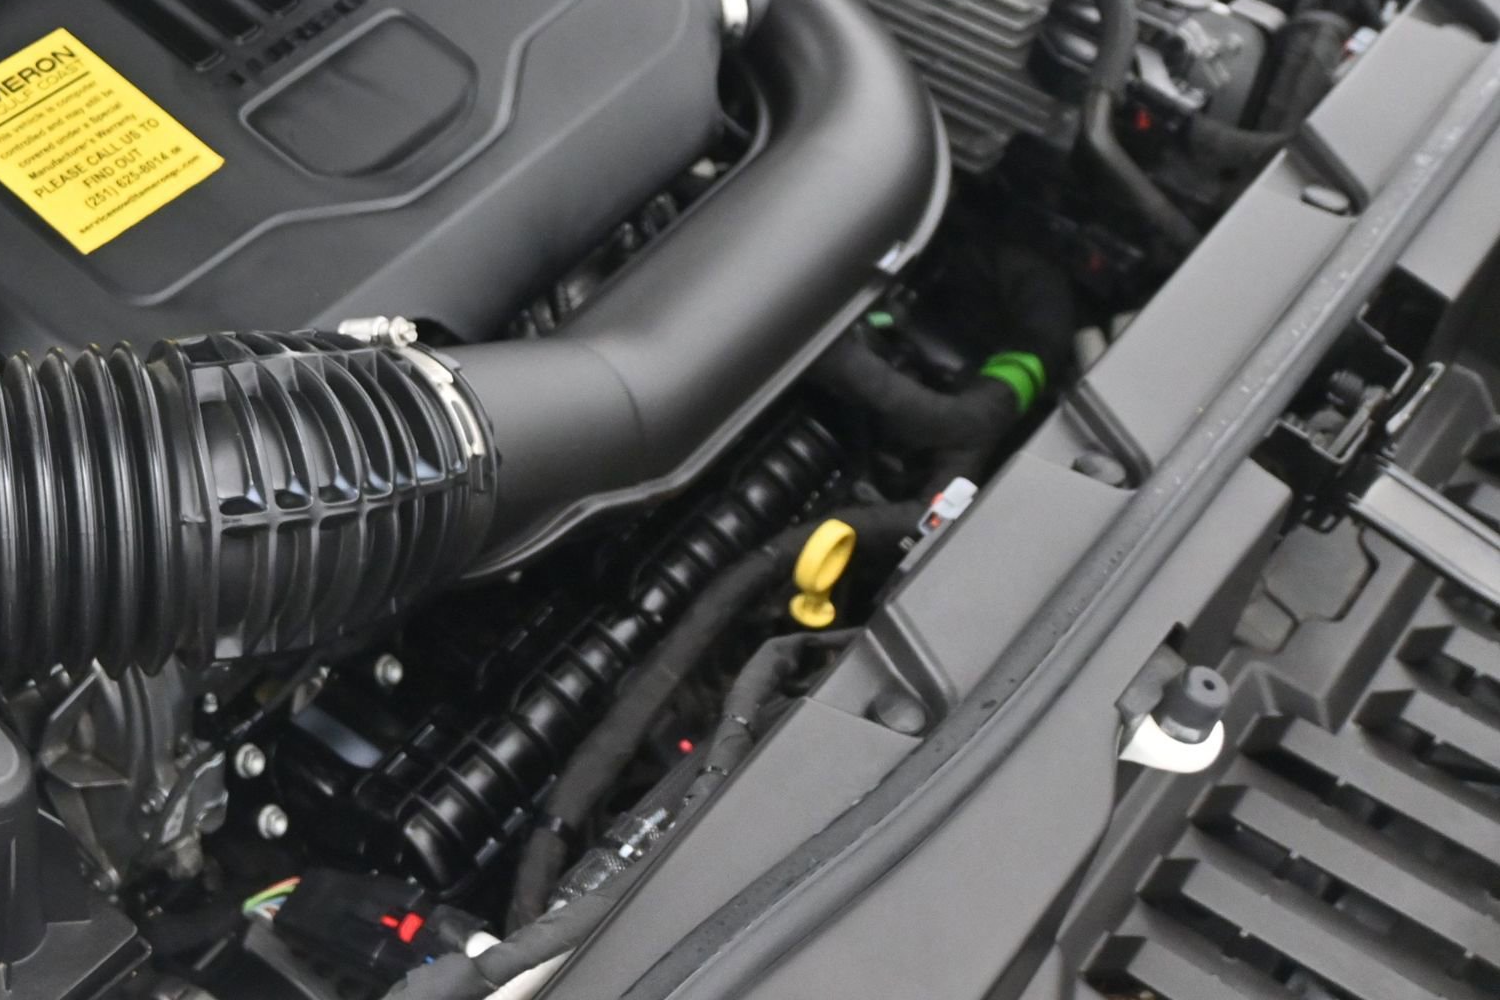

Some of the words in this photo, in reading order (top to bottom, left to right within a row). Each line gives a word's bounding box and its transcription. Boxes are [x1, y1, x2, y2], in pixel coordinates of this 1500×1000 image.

[33, 163, 86, 198] PLEASE
[85, 143, 122, 166] CALL
[119, 129, 142, 145] US
[138, 118, 160, 132] TO
[81, 166, 115, 189] FIND
[113, 147, 142, 169] OUT
[84, 186, 119, 210] (251)
